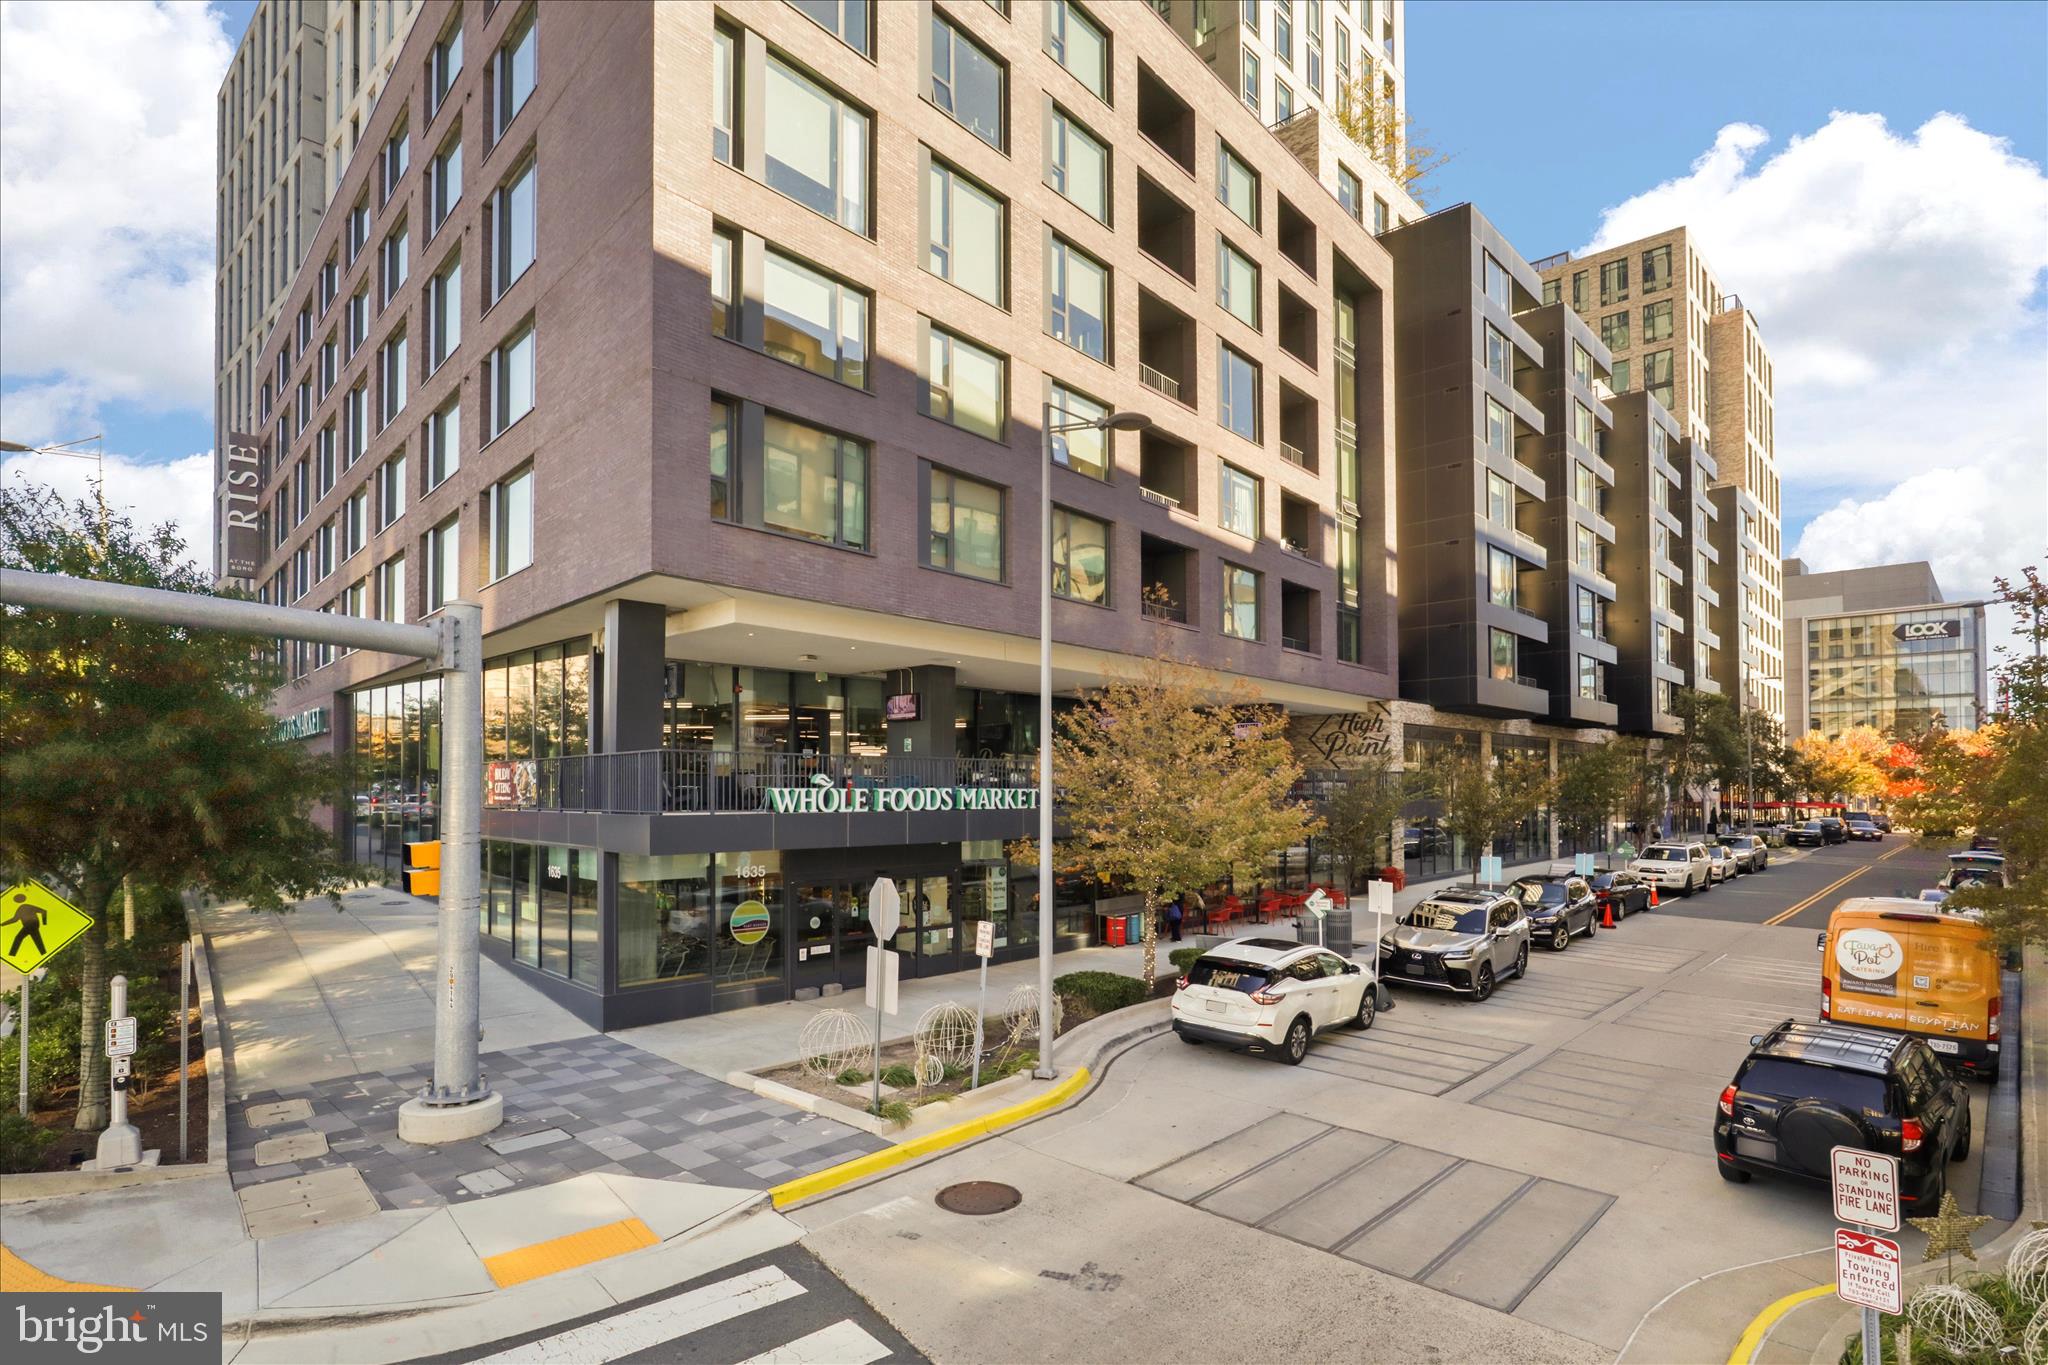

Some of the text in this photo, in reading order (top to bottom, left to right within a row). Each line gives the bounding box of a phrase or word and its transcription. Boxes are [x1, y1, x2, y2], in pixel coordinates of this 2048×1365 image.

[227, 444, 259, 531] RISE
[1905, 621, 1948, 637] LOOK
[1338, 712, 1383, 737] High
[1325, 731, 1391, 760] Point
[769, 786, 1040, 813] WHOLE FOODS MARKET
[547, 864, 561, 879] 1635
[736, 865, 766, 879] 1635
[1843, 940, 1878, 955] Fava
[1854, 950, 1881, 965] Pot
[1851, 965, 1886, 974] CATERING
[1837, 1006, 1980, 1032] EAT LIKE AN EGYPTIAN
[1855, 1157, 1871, 1169] NO
[1839, 1165, 1889, 1183] PARKING
[1839, 1183, 1892, 1202] STANDING
[1840, 1194, 1892, 1215] FIRE LANE
[1847, 1259, 1890, 1281] Towing
[1842, 1269, 1895, 1291] Enforced
